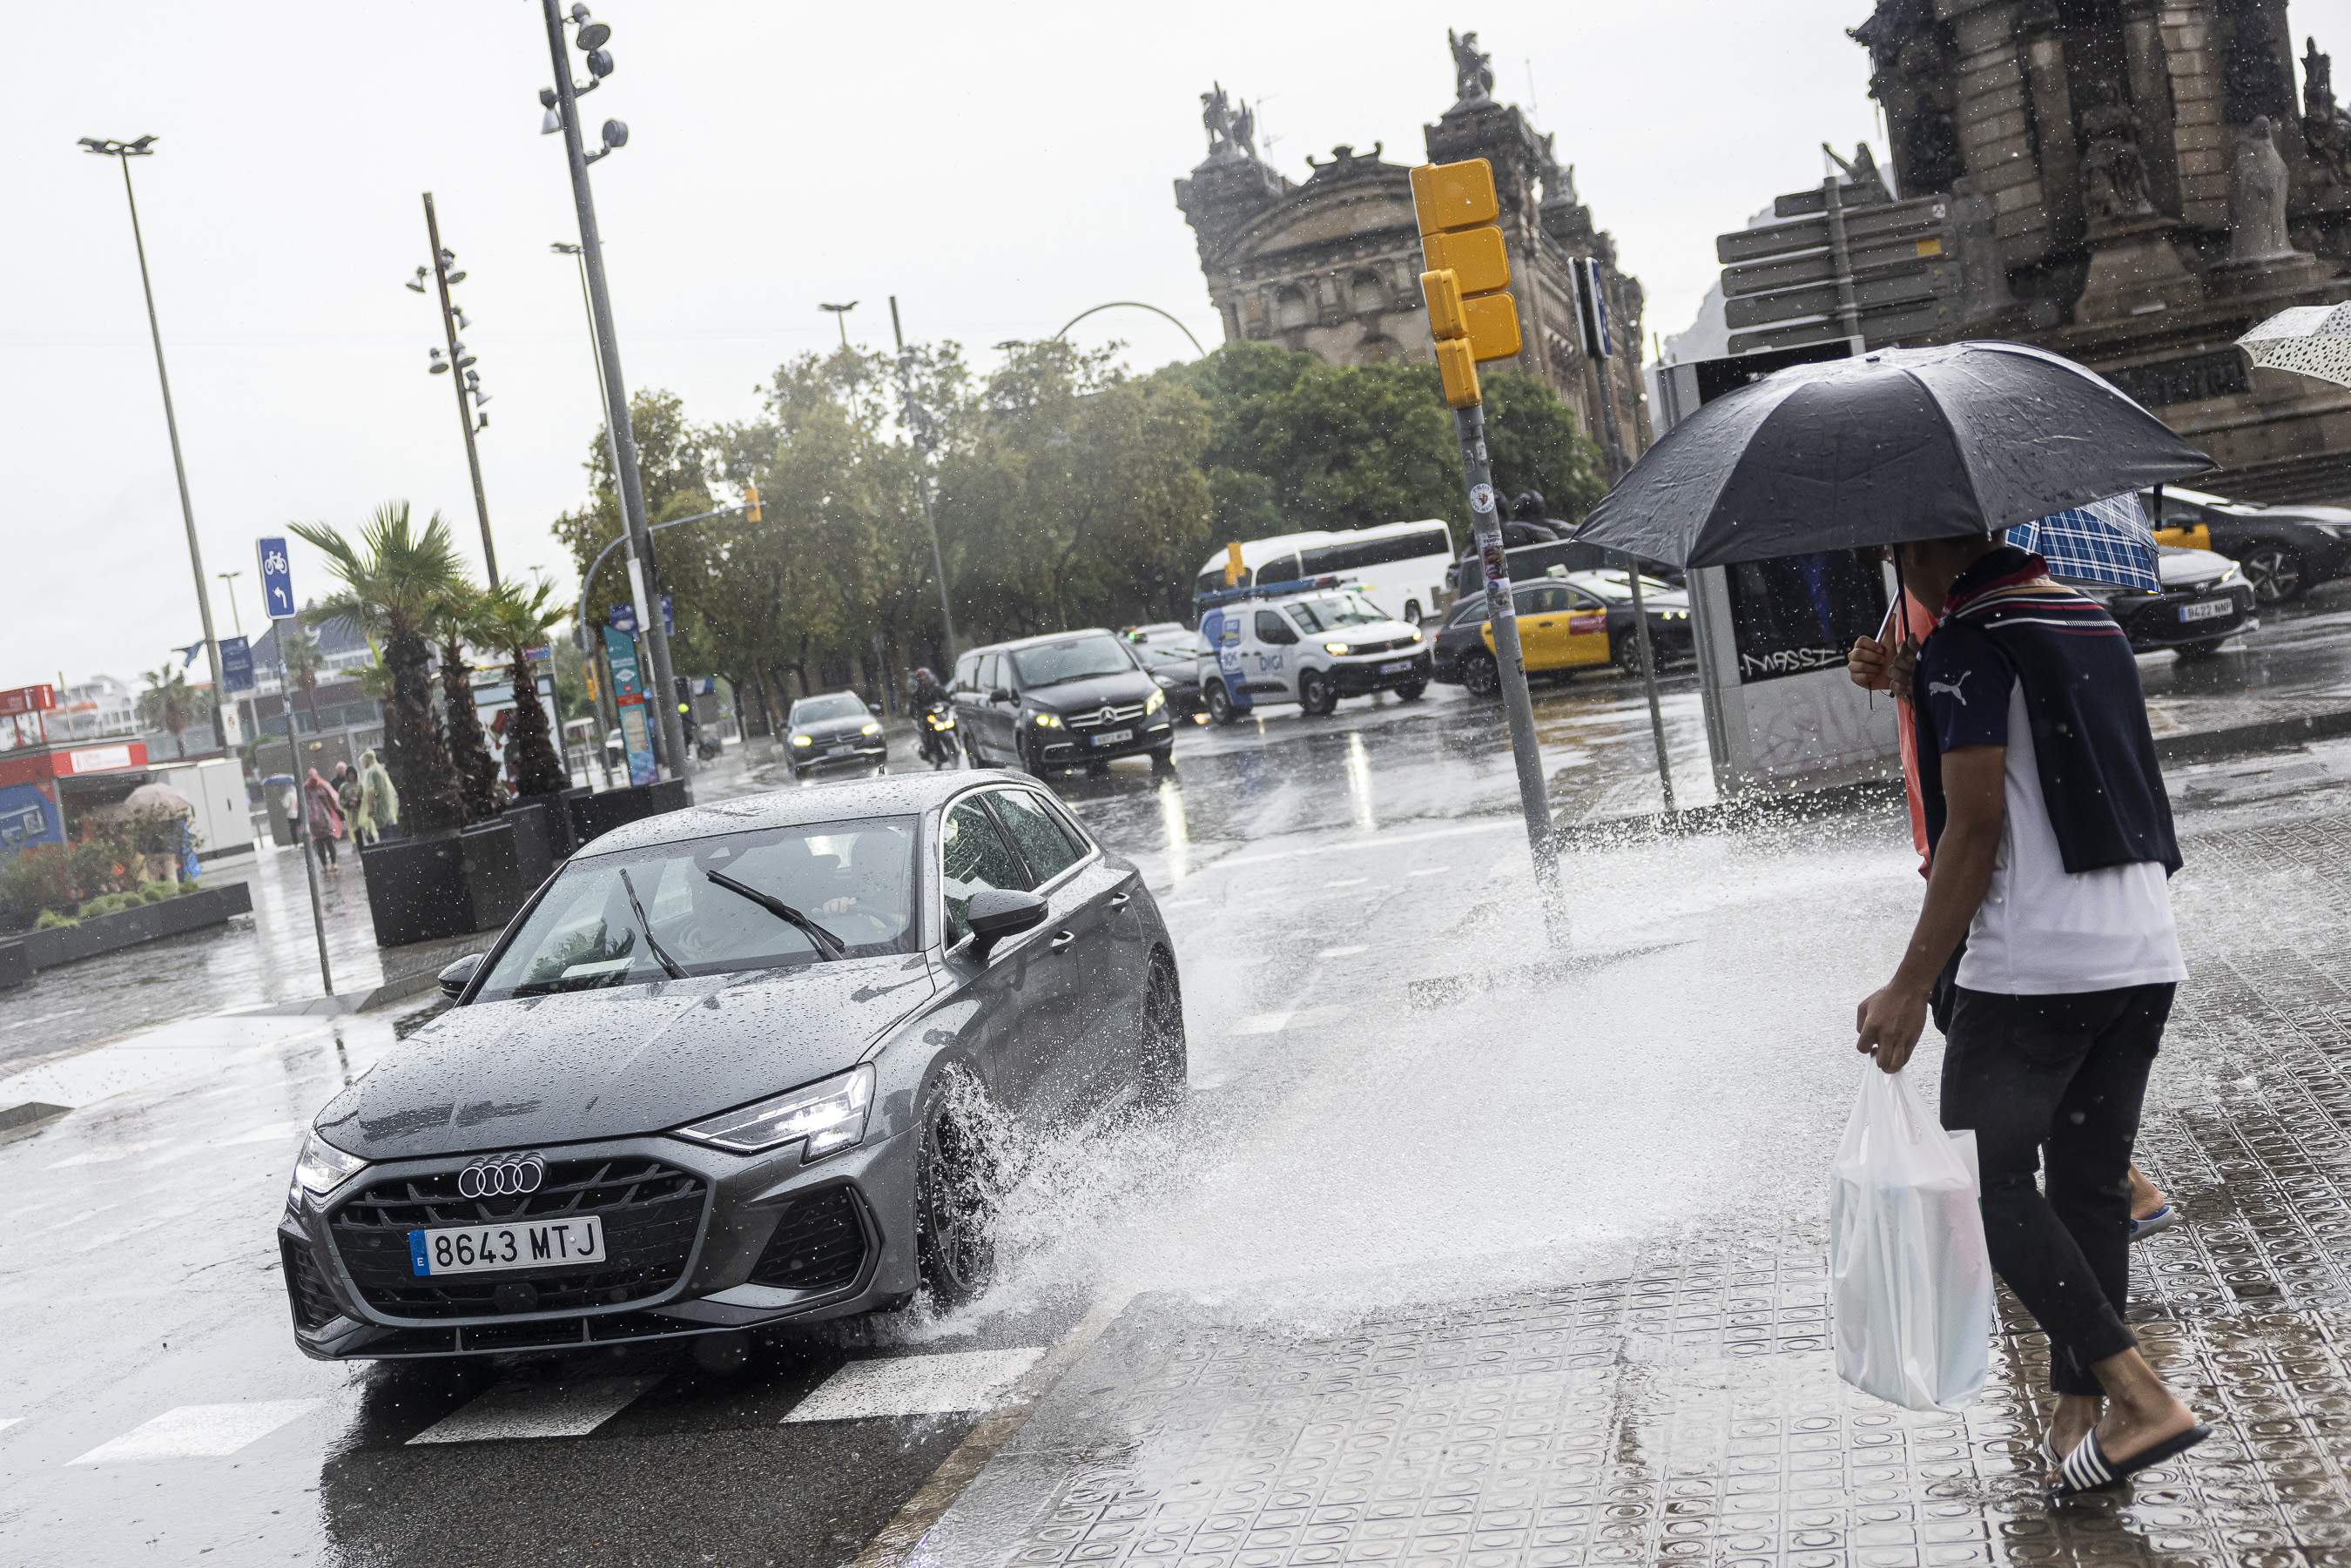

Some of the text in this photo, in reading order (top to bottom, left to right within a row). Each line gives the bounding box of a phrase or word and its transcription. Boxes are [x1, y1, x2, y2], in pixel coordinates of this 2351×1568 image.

[416, 1222, 595, 1267] E 8643 MTJ
